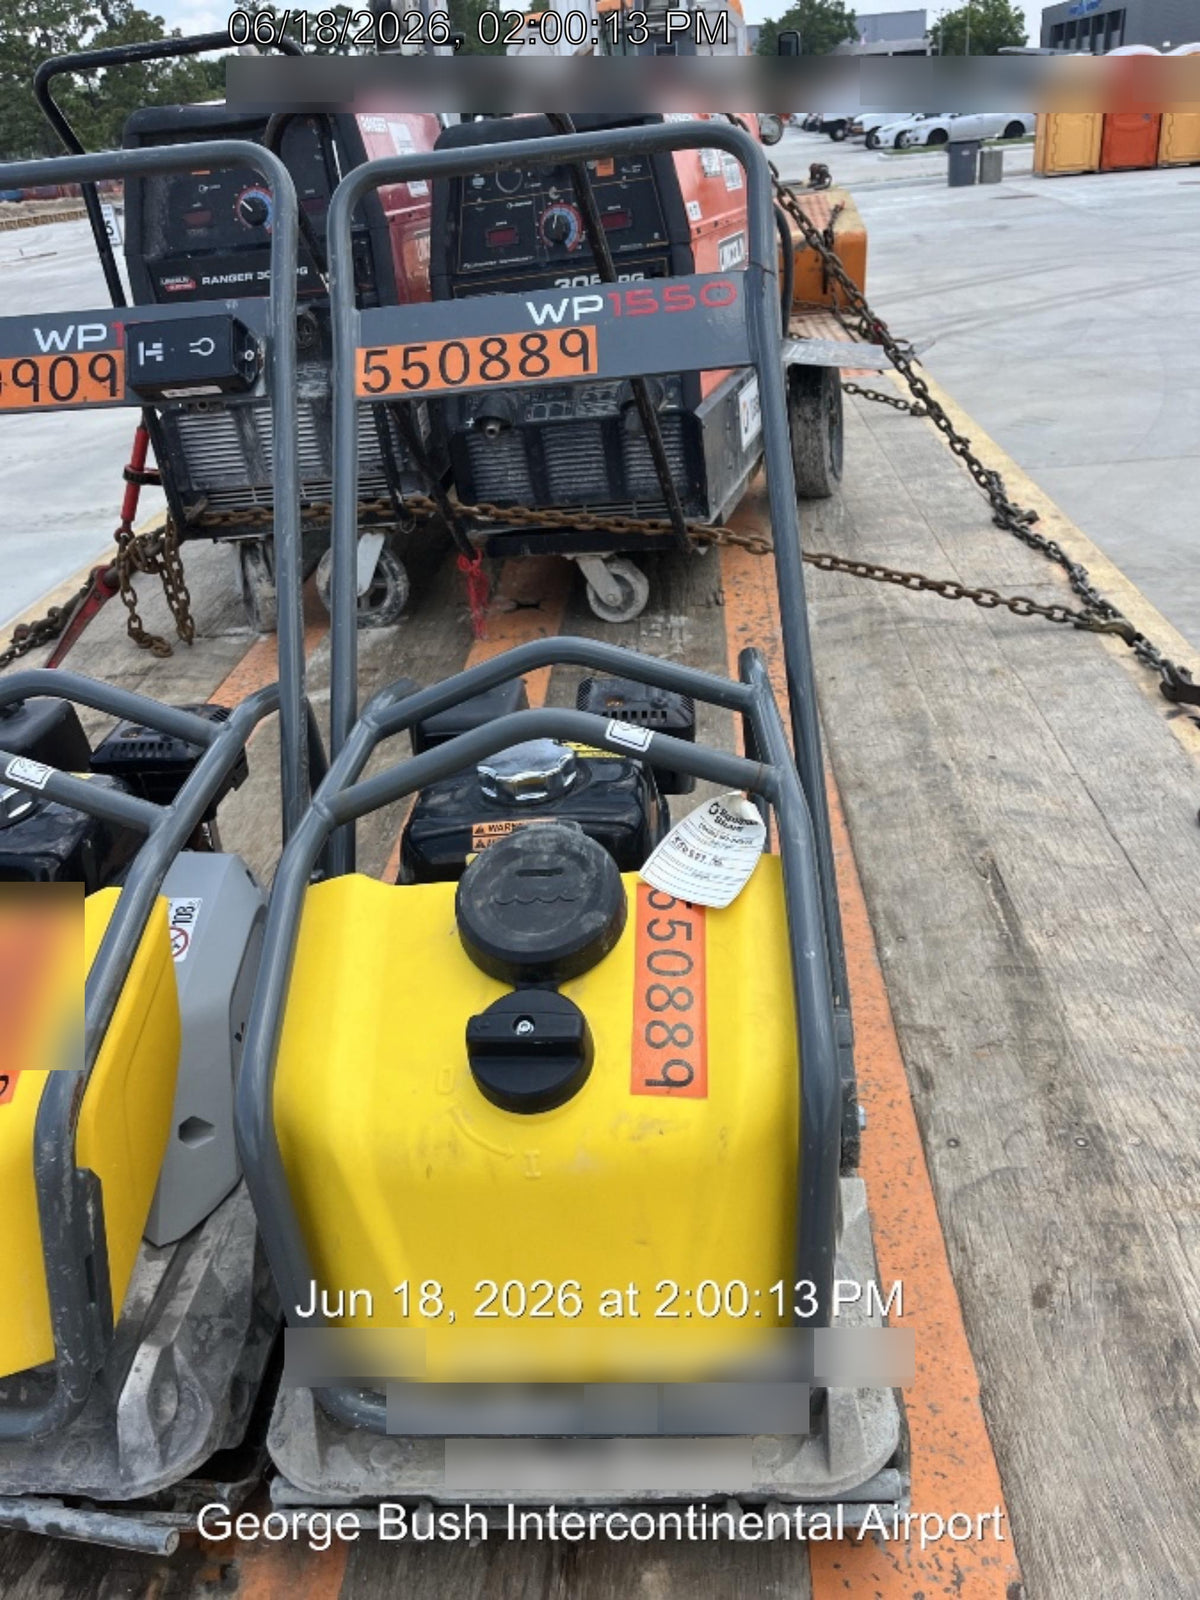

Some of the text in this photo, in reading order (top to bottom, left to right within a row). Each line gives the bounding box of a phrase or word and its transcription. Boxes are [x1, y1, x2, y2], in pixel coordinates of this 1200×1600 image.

[201, 273, 254, 286] RANGER
[525, 279, 738, 326] WP1550
[33, 321, 125, 353] WP1
[0, 353, 117, 403] 909
[361, 328, 590, 394] 550889
